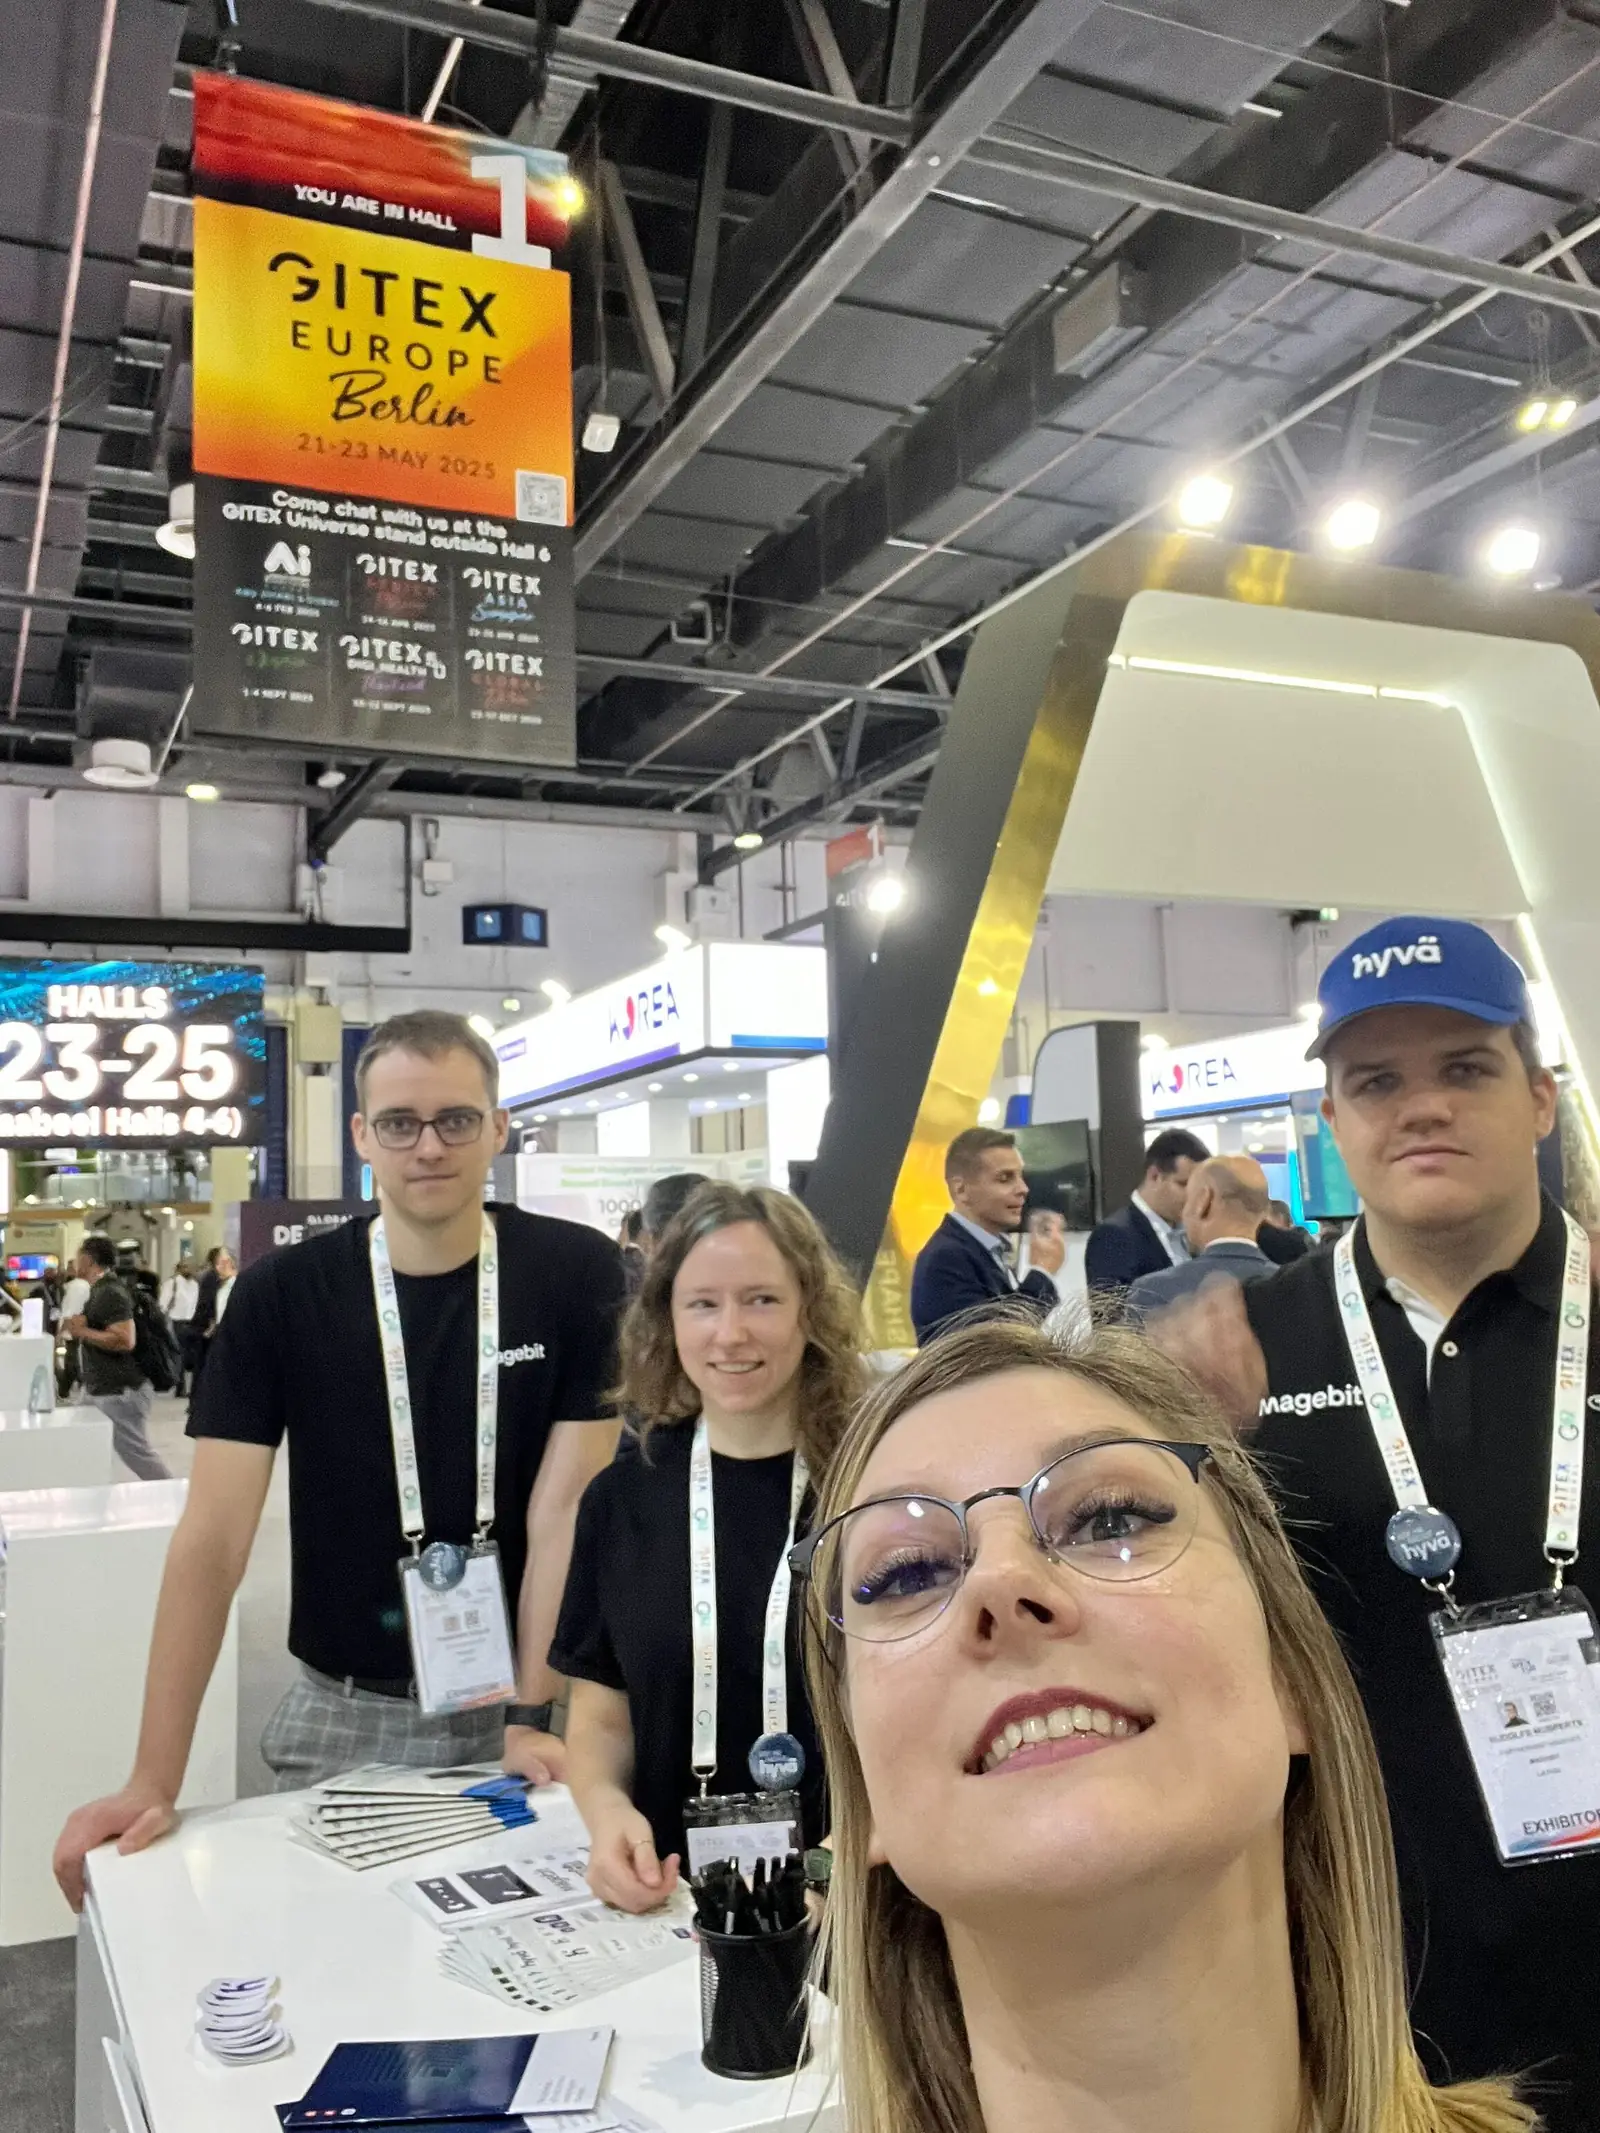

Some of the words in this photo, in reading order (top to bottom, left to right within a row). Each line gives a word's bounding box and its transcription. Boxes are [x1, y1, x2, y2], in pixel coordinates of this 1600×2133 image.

[294, 184, 337, 206] YOU
[341, 194, 380, 216] ARE
[384, 203, 404, 220] IN
[409, 207, 457, 231] HALL
[471, 156, 552, 270] 1
[269, 252, 498, 339] GITEX
[292, 320, 502, 385] EUROPE
[329, 370, 474, 428] Berlin
[297, 432, 368, 459] 21-23
[378, 445, 428, 469] MAY
[440, 455, 496, 479] 2025
[222, 502, 282, 525] GITEX
[286, 510, 370, 537] Universe
[374, 525, 426, 545] stand
[430, 535, 499, 554] outside
[501, 540, 535, 560] Hall
[272, 490, 330, 514] Come
[334, 501, 377, 520] chat
[381, 509, 423, 528] with
[427, 517, 449, 531] us
[453, 519, 473, 534] at
[476, 520, 507, 539] the
[356, 553, 438, 583] GITEX
[462, 567, 541, 596] GITEX
[232, 623, 318, 652] GITEX
[339, 634, 422, 664] GITEX
[465, 649, 543, 677] GITEX
[1352, 935, 1442, 980] hyvä
[48, 985, 169, 1019] HALLS
[0, 1022, 235, 1101] 23-25
[106, 1106, 180, 1136] Halls
[1258, 1383, 1364, 1416] magebit
